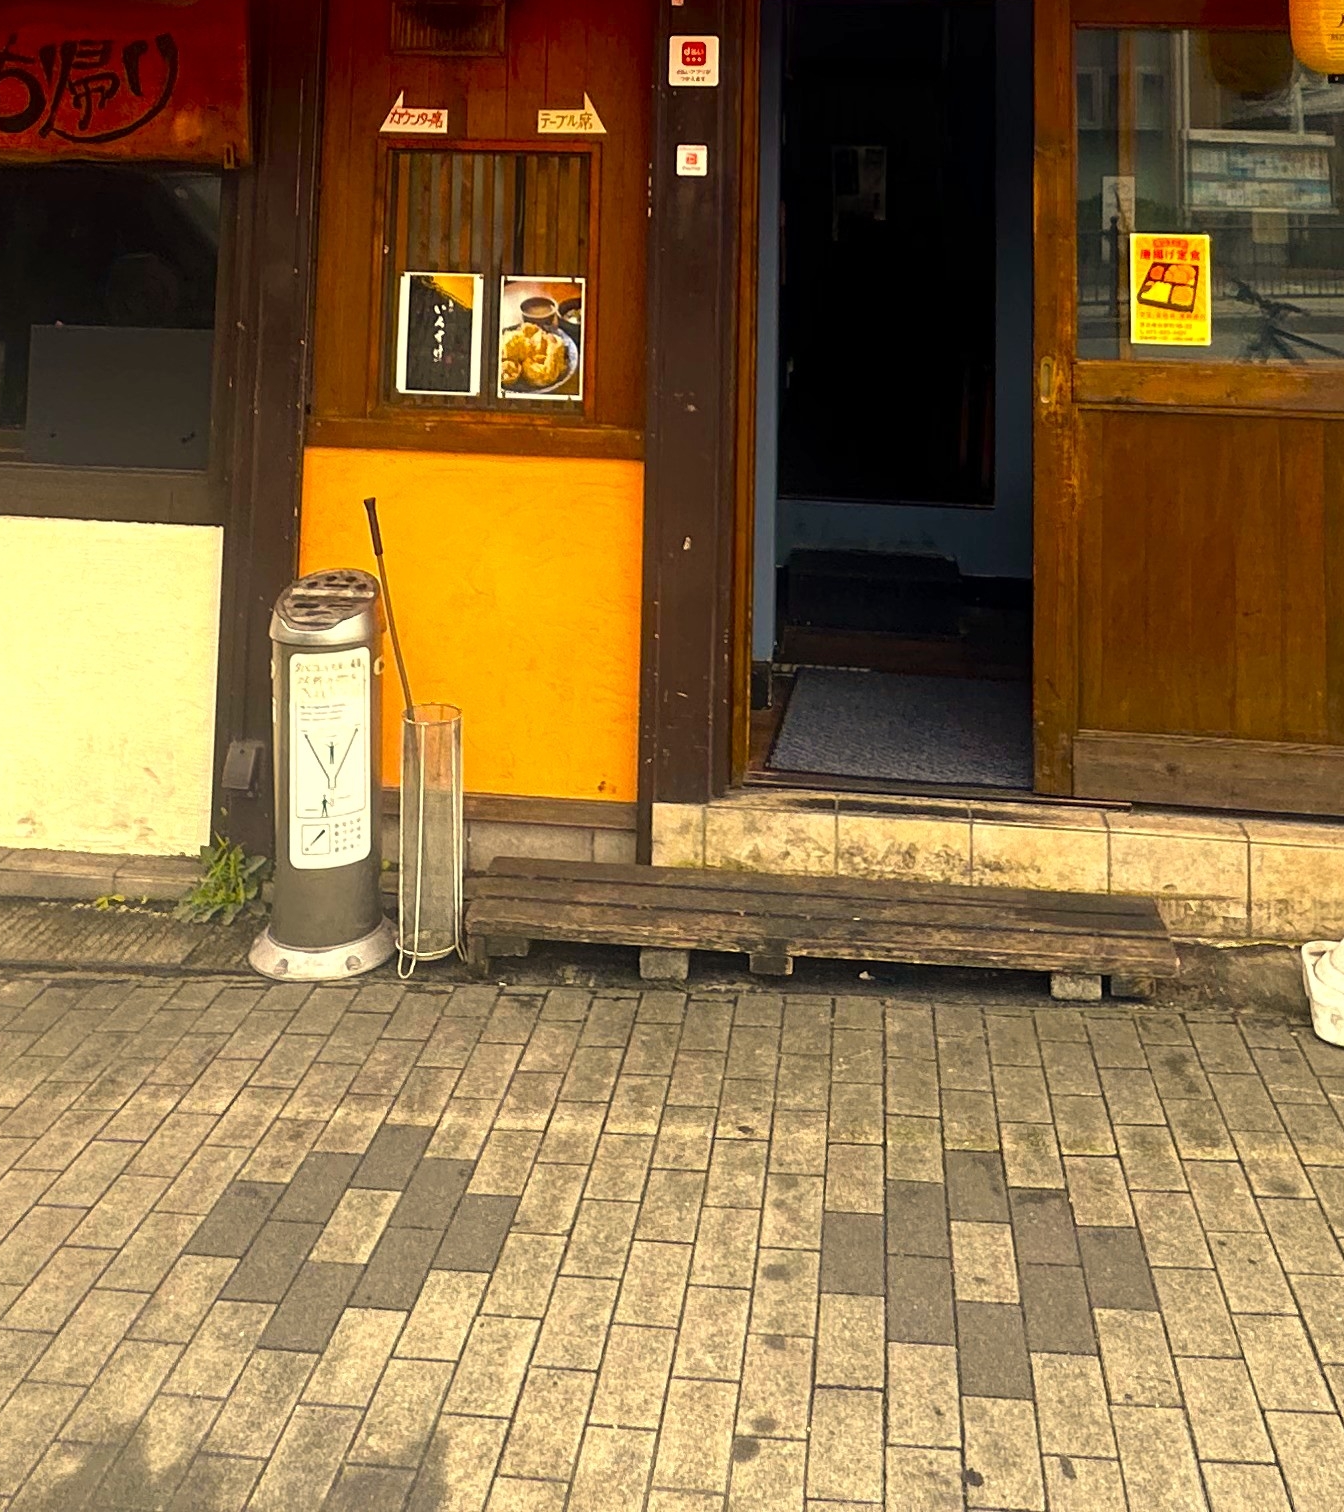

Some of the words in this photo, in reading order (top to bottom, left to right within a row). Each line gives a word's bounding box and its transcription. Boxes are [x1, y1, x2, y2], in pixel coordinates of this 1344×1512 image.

[540, 111, 594, 130] テーブル席
